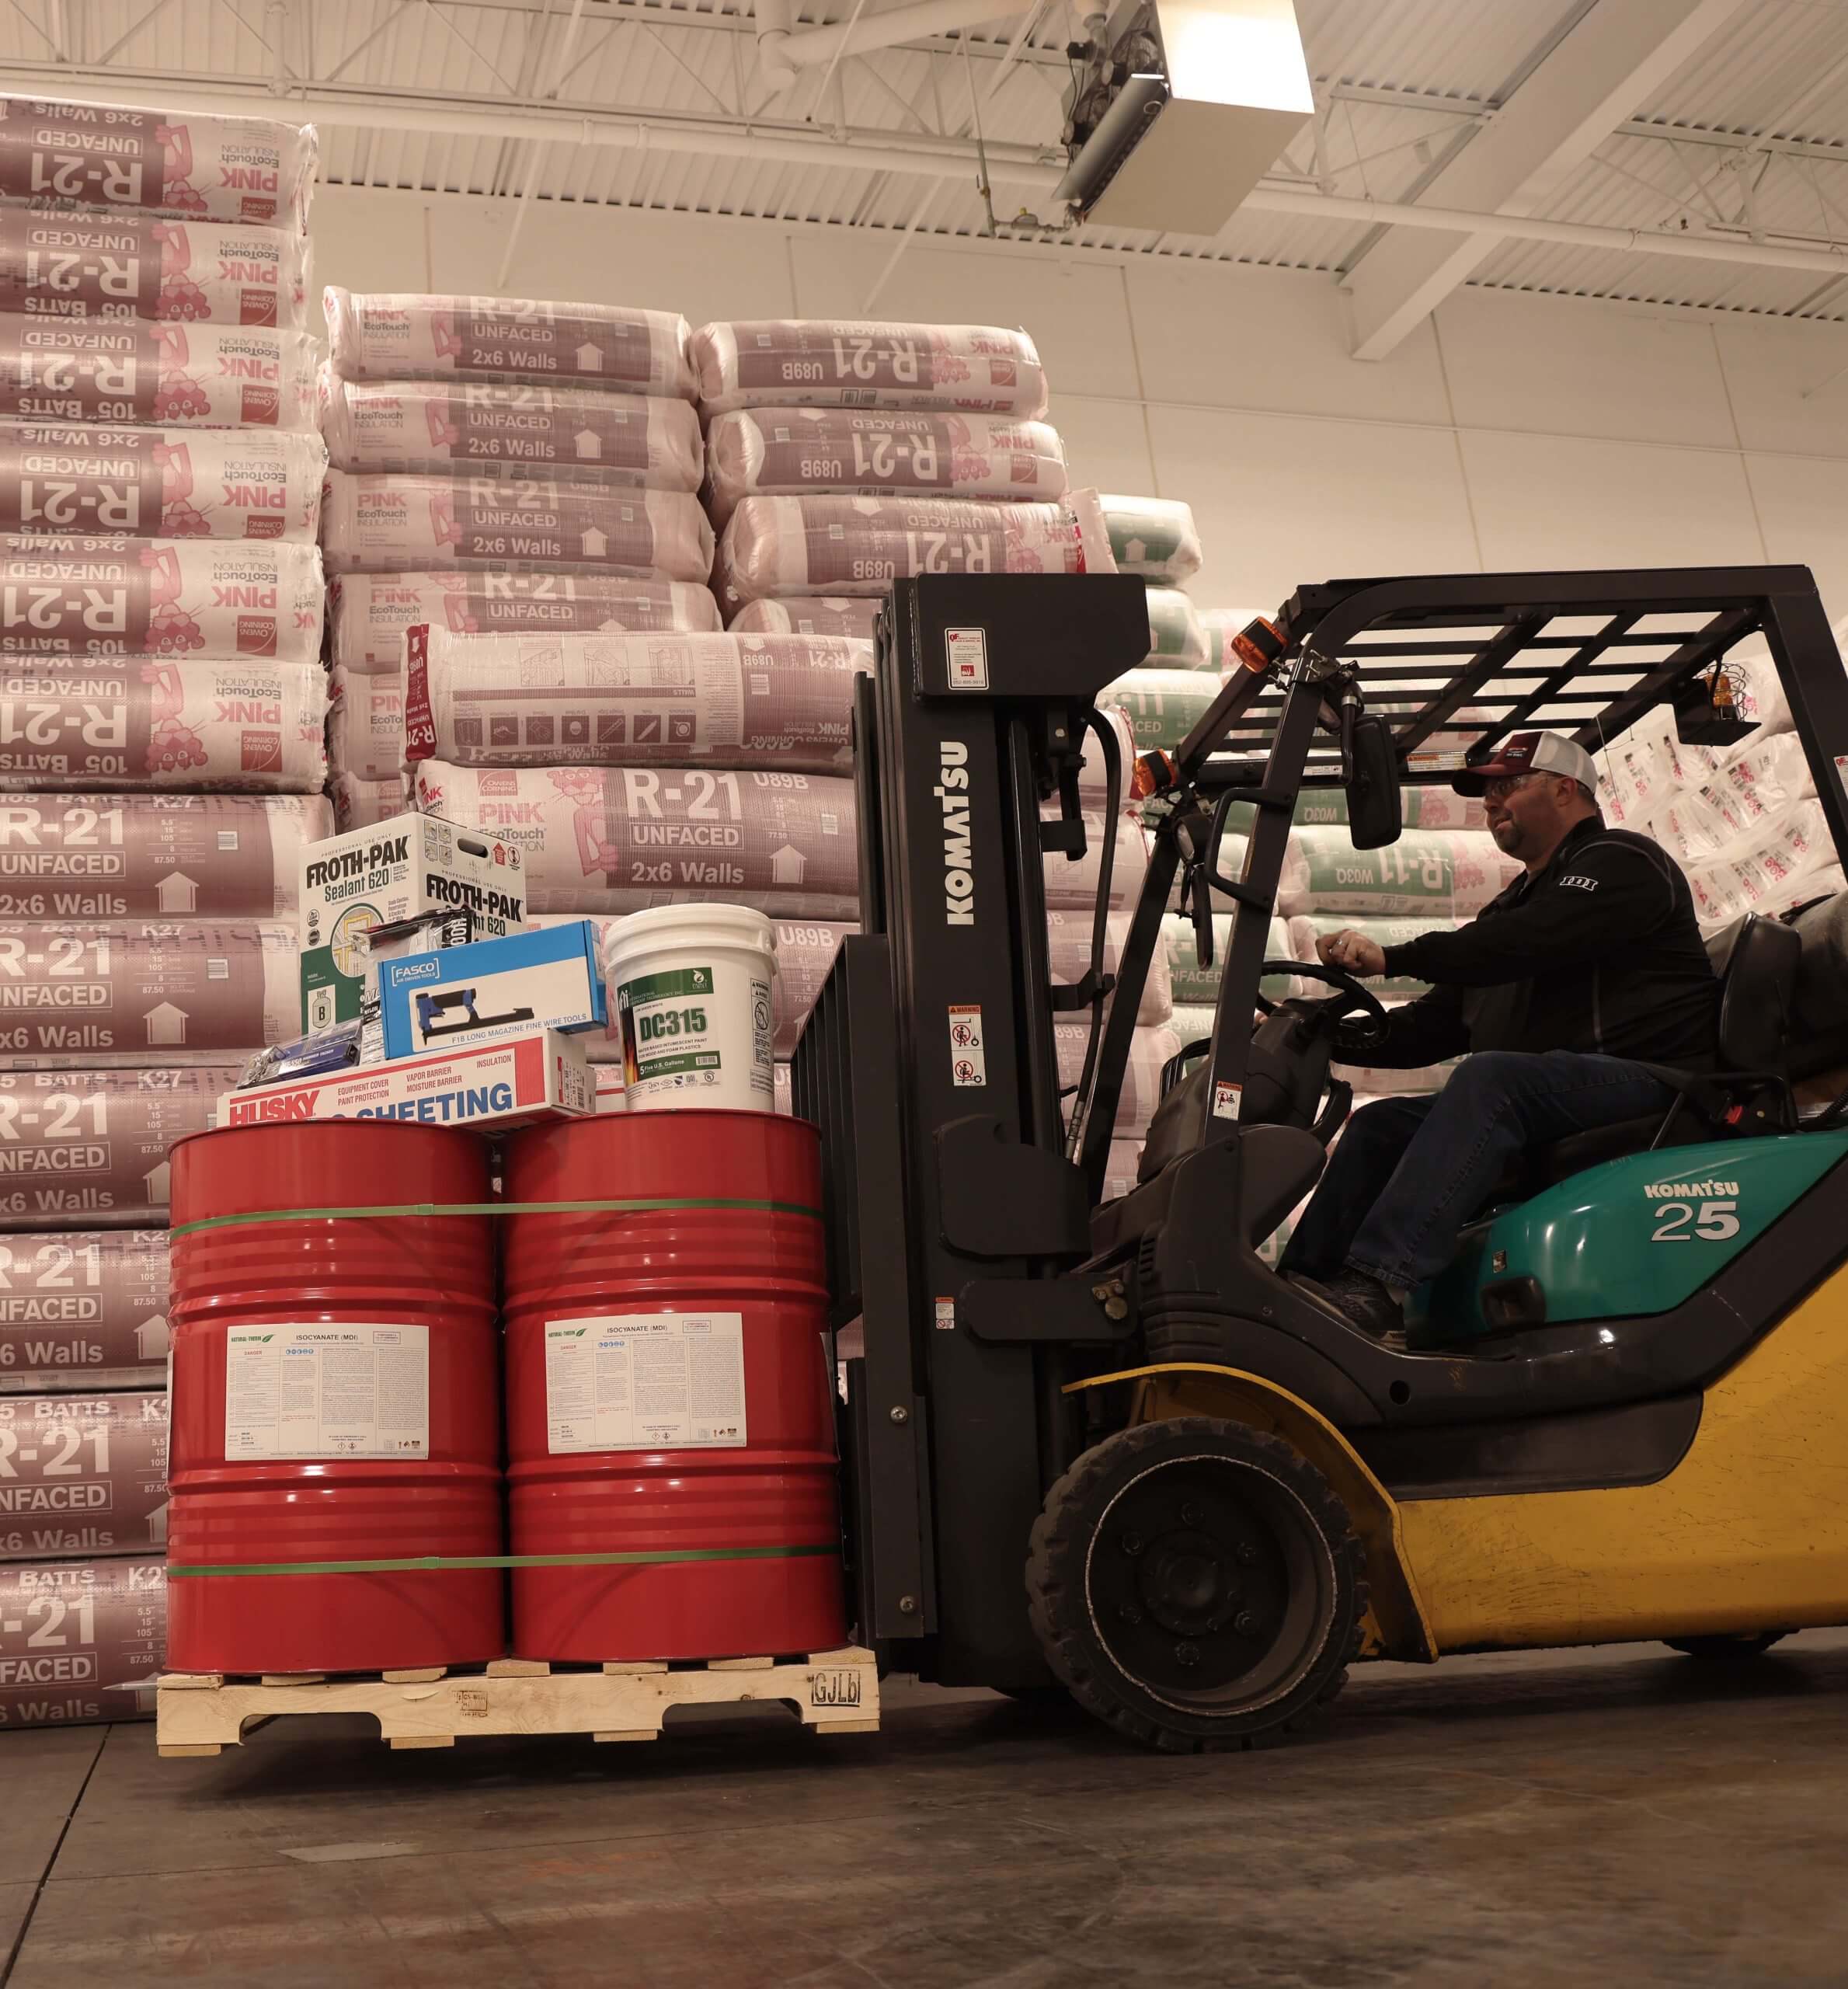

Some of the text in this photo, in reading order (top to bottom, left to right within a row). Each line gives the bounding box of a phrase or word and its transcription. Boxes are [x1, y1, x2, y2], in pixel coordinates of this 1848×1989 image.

[36, 104, 143, 127] 2x6 Walls
[37, 130, 138, 154] UNFACED
[31, 153, 142, 204] R-21
[220, 167, 278, 192] PINK
[32, 231, 135, 250] UNFACED
[220, 249, 279, 261] EcoTouch
[26, 251, 138, 298] R-21
[219, 261, 277, 284] PINK
[26, 333, 132, 350] UNFACED
[474, 325, 553, 342] UNFACED
[218, 346, 280, 359] EcoTouch
[219, 337, 279, 352] INSULATION
[218, 357, 278, 380] PINK
[472, 349, 557, 370] 2x6 Walls
[834, 338, 918, 382] R-21
[20, 352, 136, 395] R-21
[782, 363, 823, 379] U89B
[19, 398, 82, 419] BATTS
[469, 413, 551, 429] UNFACED
[852, 419, 929, 430] UNFACED
[23, 428, 139, 448] 2x6 Walls
[468, 438, 555, 458] 2x6 Walls
[854, 434, 938, 480] R-21
[25, 457, 135, 476] UNFACED
[224, 461, 286, 471] INSULATION
[801, 460, 841, 478] U89B
[223, 471, 286, 482] EcoTouch
[222, 485, 286, 508] PINK
[358, 493, 406, 507] PINK
[469, 478, 559, 510] R-21
[20, 480, 139, 528] R-21
[474, 511, 556, 527] UNFACED
[907, 515, 983, 529] UNFACED
[5, 537, 125, 552] 2x6 Walls
[473, 537, 561, 556] 2x6 Walls
[907, 532, 990, 573] R-21
[9, 563, 121, 580] UNFACED
[214, 562, 277, 572] INSULATION
[853, 560, 894, 578] U89B
[213, 572, 277, 583] EcoTouch
[483, 572, 576, 601] R-21
[211, 586, 277, 608] PINK
[371, 589, 422, 602] PINK
[3, 586, 127, 632] R-21
[490, 604, 573, 618] UNFACED
[238, 622, 273, 630] CORNING
[239, 629, 267, 637] OWENS
[2, 636, 69, 651] BATTS
[743, 655, 773, 665] U89B
[6, 679, 121, 696] UNFACED
[216, 678, 282, 688] INSULATION
[214, 687, 281, 699] EcoTouch
[215, 702, 280, 724] PINK
[0, 702, 127, 748] R-21
[819, 723, 848, 735] PINK
[244, 744, 273, 752] OWENS
[0, 753, 68, 773] BATTS
[753, 772, 808, 789] U89B
[622, 768, 741, 820] R-21
[479, 802, 545, 824] PINK
[0, 808, 123, 845] R-21
[633, 826, 739, 845] UNFACED
[934, 741, 974, 925] KOMATSU
[2, 855, 121, 875] UNFACED
[306, 835, 409, 889] FROTH-PAK
[1380, 848, 1443, 889] R-11
[632, 862, 743, 883] 2x6 Walls
[1336, 868, 1373, 884] W03Q
[325, 876, 365, 902] Sealant
[368, 868, 388, 890] 620
[1, 893, 127, 914] 2x6 Walls
[426, 873, 521, 923] FROTH-PAK
[488, 917, 505, 936] 620
[778, 925, 834, 946] U89B
[396, 963, 434, 978] FASCO
[319, 1006, 325, 1021] B
[467, 1033, 486, 1041] LONG
[488, 1025, 524, 1038] MAGAZINE
[526, 1021, 542, 1030] FINE
[544, 1018, 562, 1027] WIRE
[563, 1013, 586, 1024] TOOLS
[640, 1008, 707, 1041] DC315
[37, 1026, 113, 1048] Walls
[476, 1054, 511, 1069] INSULATION
[640, 1066, 645, 1075] 5
[137, 1071, 183, 1088] K27
[406, 1067, 452, 1082] VAPOR BARRIER
[406, 1075, 462, 1093] MOISTURE BARRIER
[337, 1078, 388, 1096] EQUIPMENT COVER
[230, 1090, 319, 1125] HUSKY
[338, 1090, 389, 1106] PAINT PROTECTION
[1644, 1179, 1739, 1198] KOMATSU
[36, 1187, 114, 1210] Walls
[1651, 1201, 1740, 1241] 25
[25, 1340, 104, 1365] Walls
[34, 1402, 110, 1419] BATTS
[32, 1528, 114, 1549] Walls
[19, 1570, 95, 1586] BATTS
[130, 1656, 153, 1664] 87.50
[18, 1700, 99, 1723] Walls
